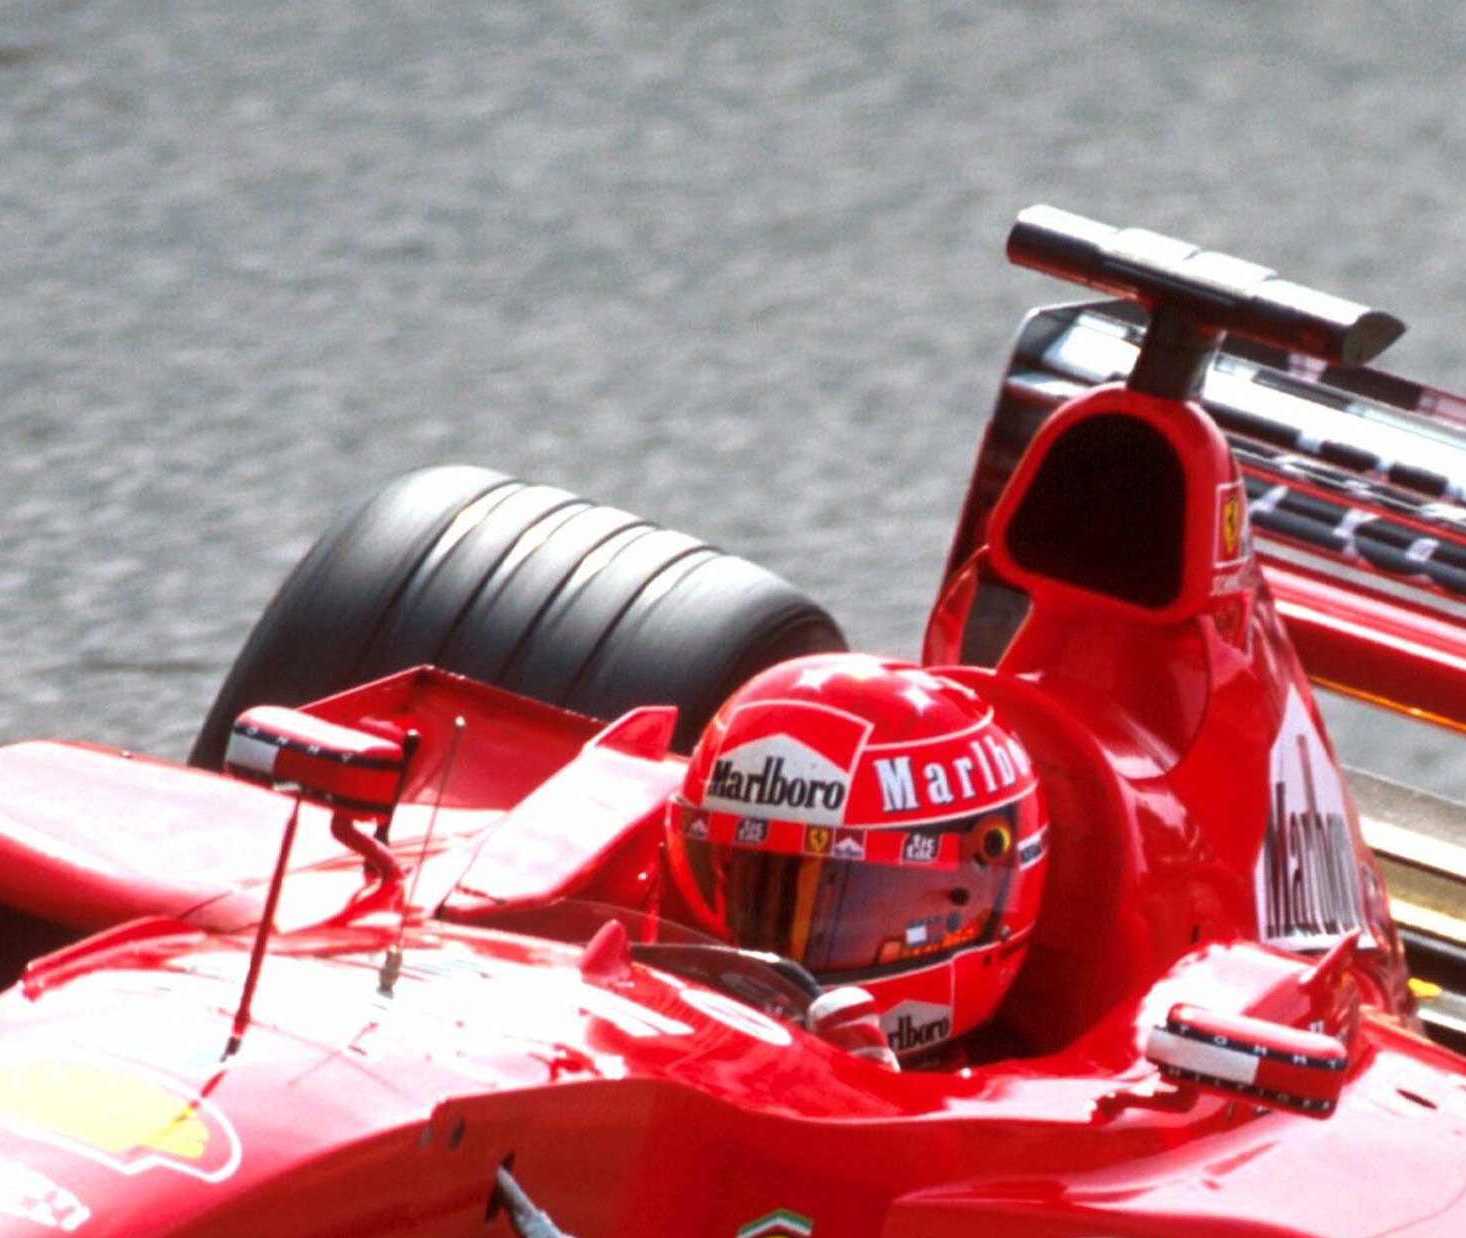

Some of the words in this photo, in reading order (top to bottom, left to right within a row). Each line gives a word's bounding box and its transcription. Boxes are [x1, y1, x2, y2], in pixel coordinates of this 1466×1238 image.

[708, 756, 846, 810] Marlboro
[872, 734, 1030, 813] Marlbo
[886, 1014, 949, 1049] rlboro
